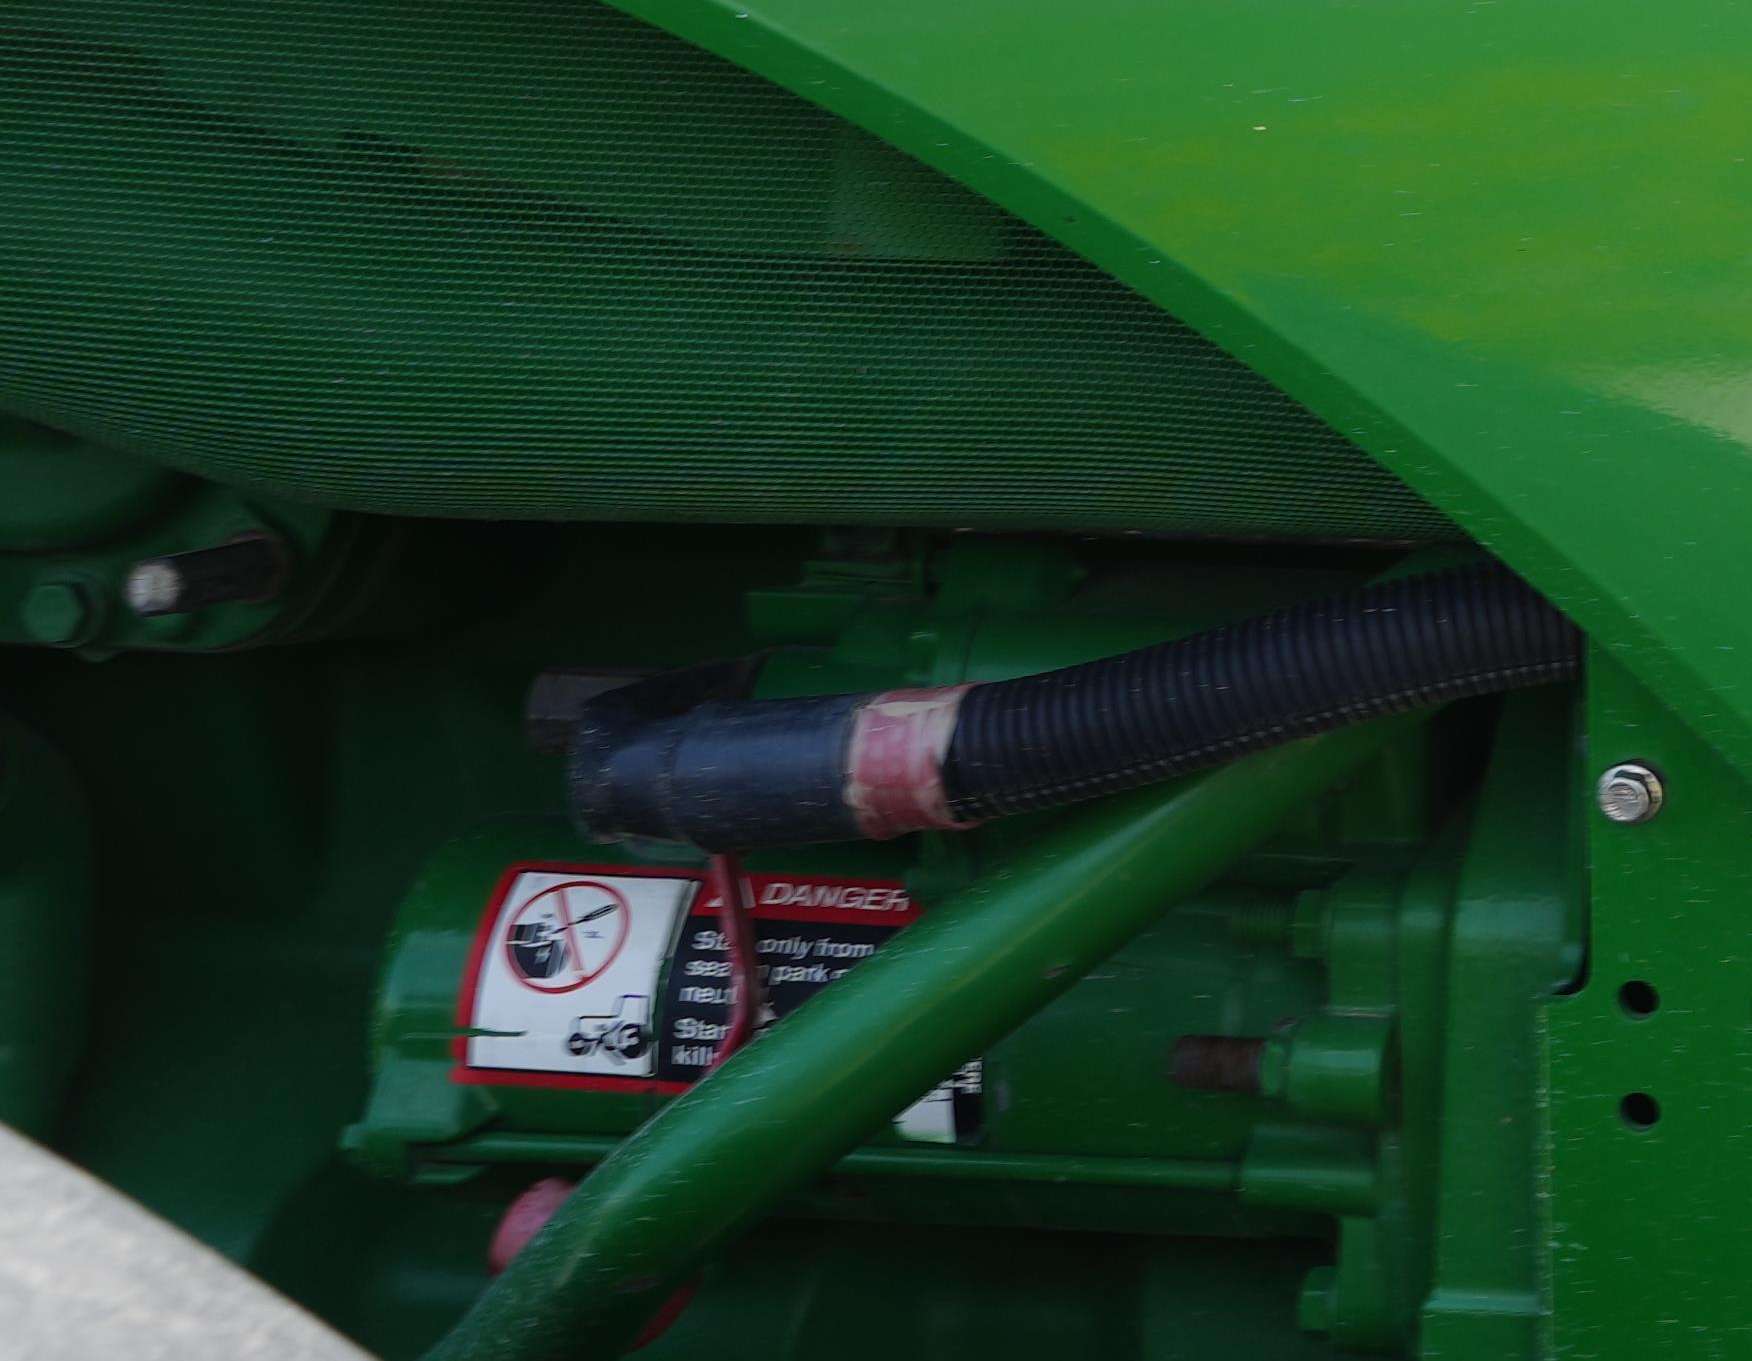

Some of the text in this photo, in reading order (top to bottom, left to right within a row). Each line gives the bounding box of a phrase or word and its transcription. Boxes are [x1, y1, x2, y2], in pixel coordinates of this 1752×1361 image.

[760, 881, 911, 911] DANGER
[755, 935, 814, 959] only
[683, 959, 735, 978] sea
[768, 962, 832, 986] park
